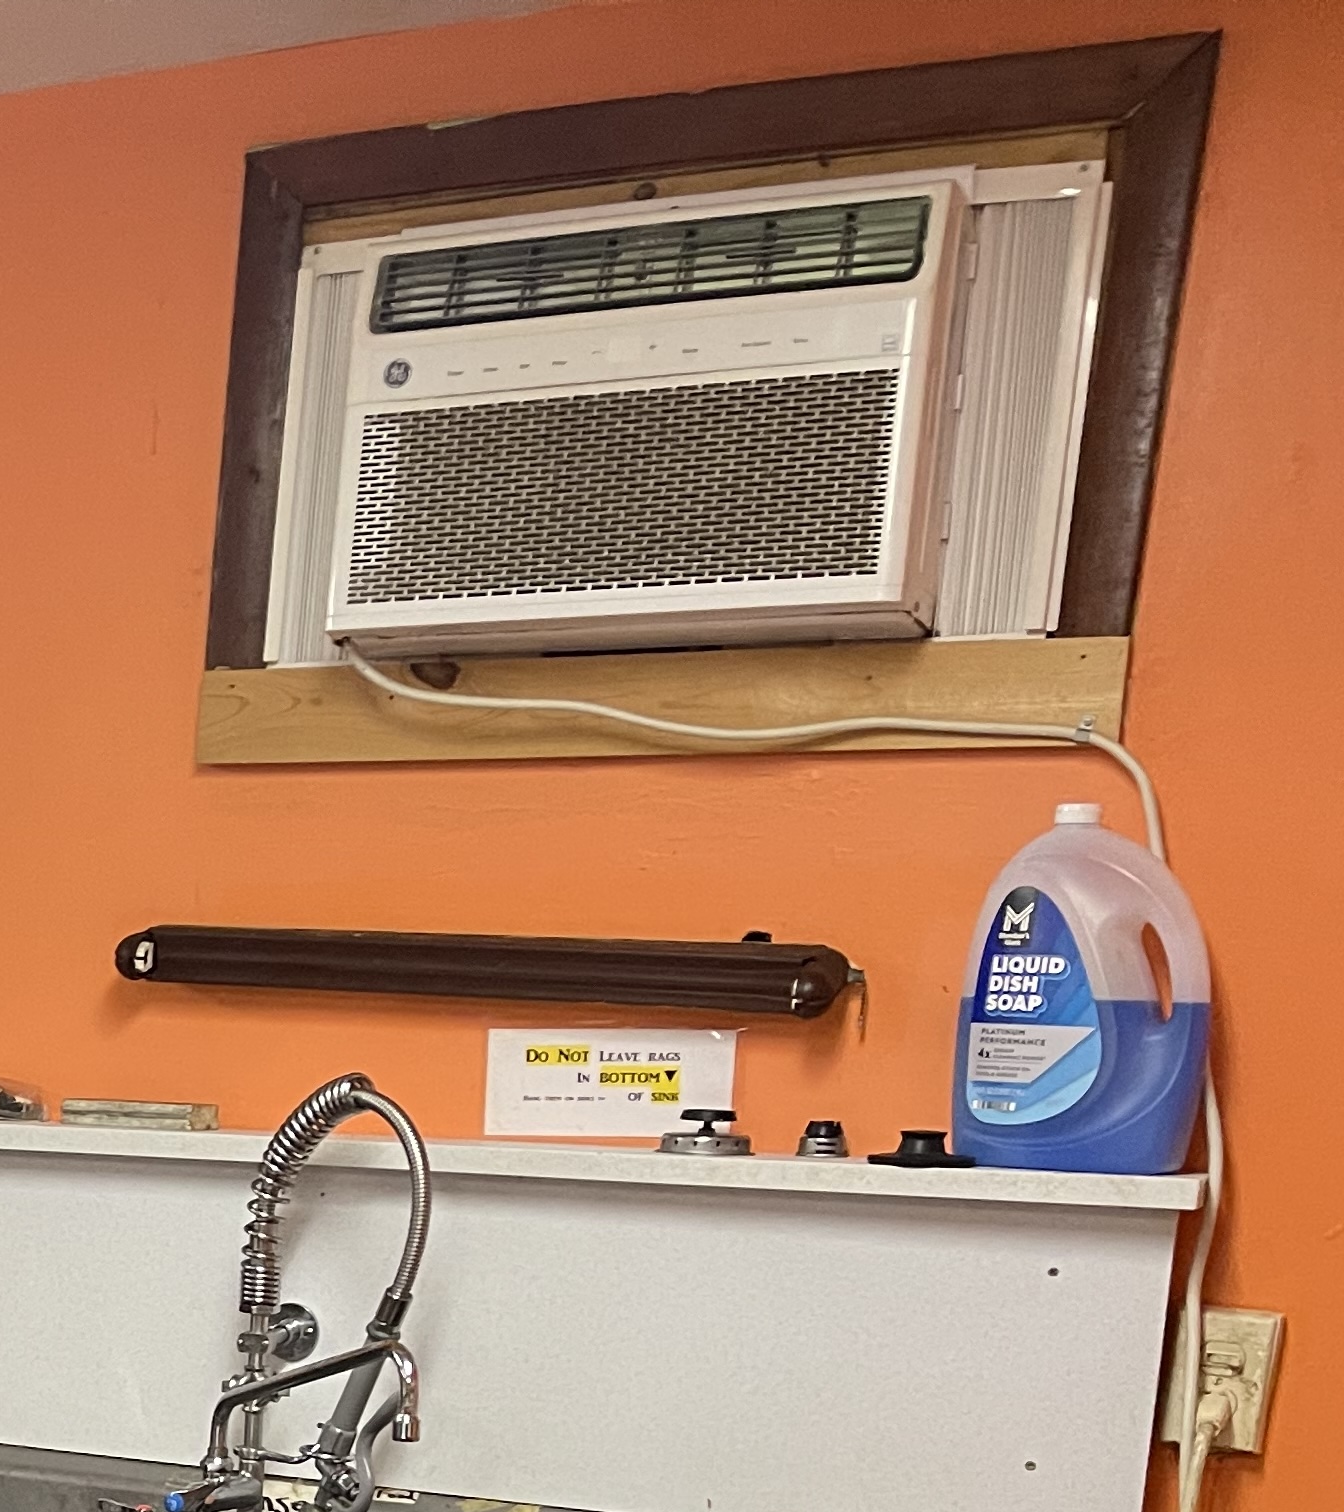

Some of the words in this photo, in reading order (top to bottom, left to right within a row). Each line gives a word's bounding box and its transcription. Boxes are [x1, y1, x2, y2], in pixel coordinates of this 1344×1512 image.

[991, 956, 1065, 974] LIQUID
[989, 975, 1039, 993] DISH
[985, 994, 1043, 1012] SOAP
[599, 1071, 661, 1084] BOTTOM
